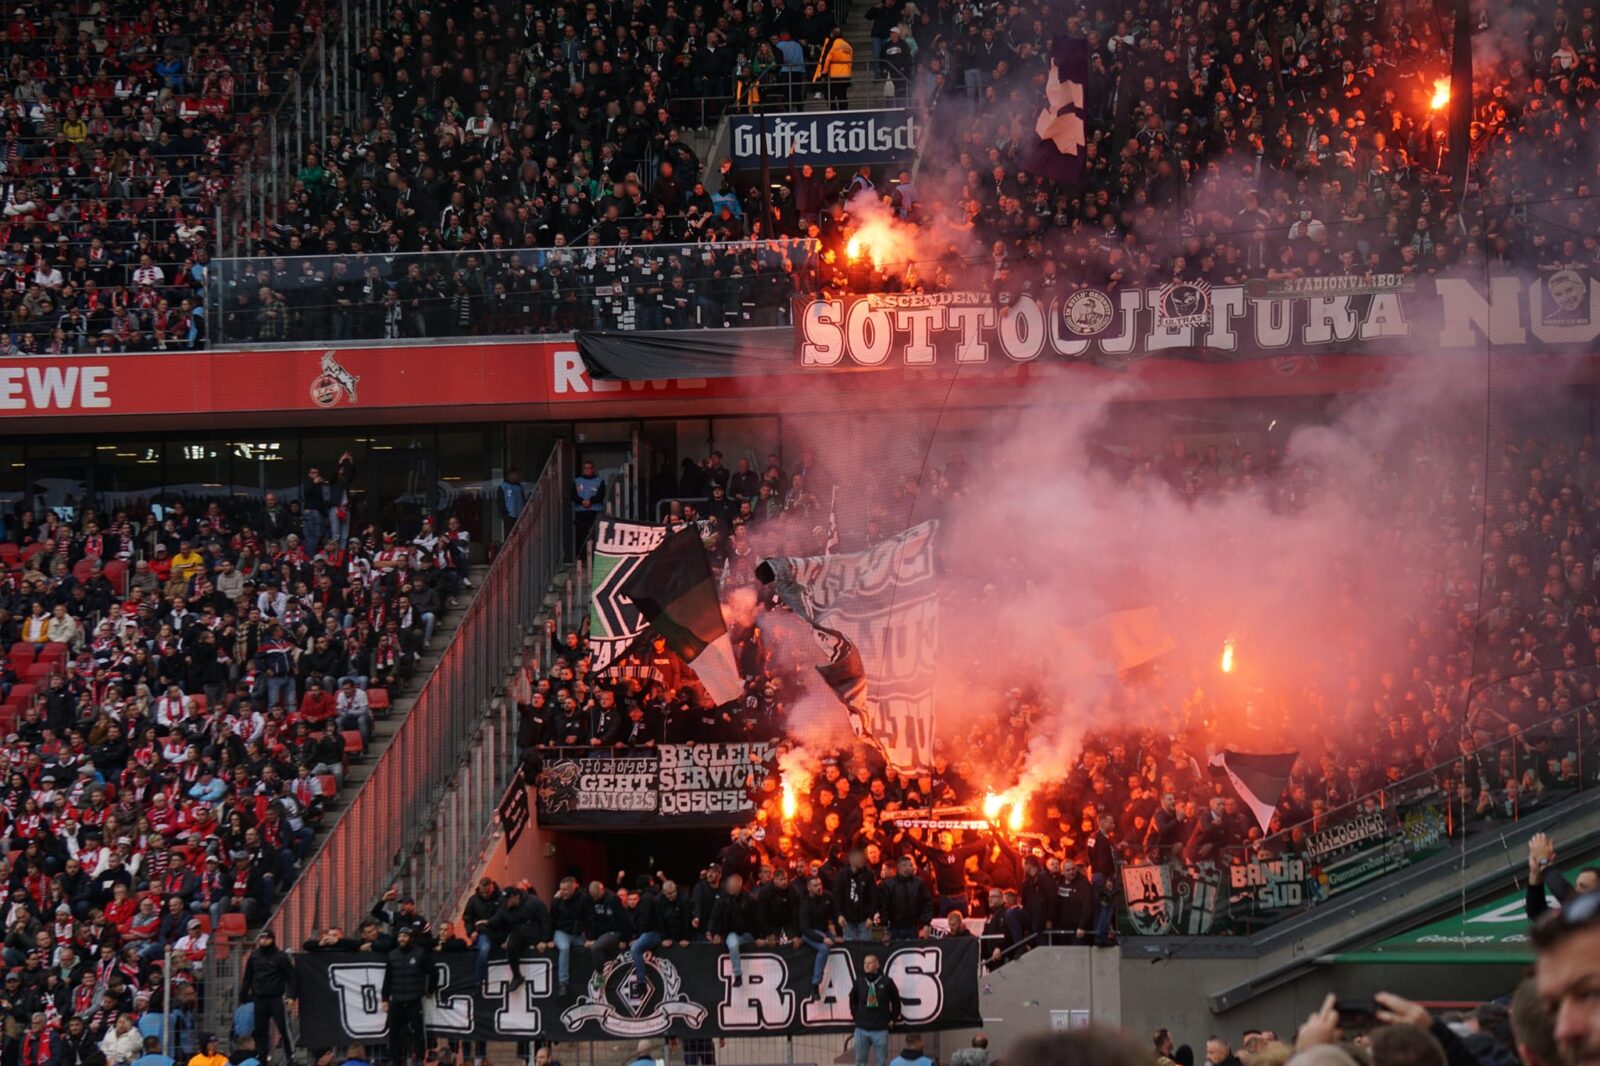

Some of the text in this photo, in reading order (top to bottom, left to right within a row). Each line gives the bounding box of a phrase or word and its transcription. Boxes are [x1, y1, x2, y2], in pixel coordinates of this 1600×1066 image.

[734, 117, 821, 159] Gaffel
[580, 758, 658, 775] HEUTE
[580, 773, 653, 792] GEHT
[576, 791, 658, 811] EINIGES
[1230, 859, 1304, 888] BANDA
[615, 950, 654, 963] 190
